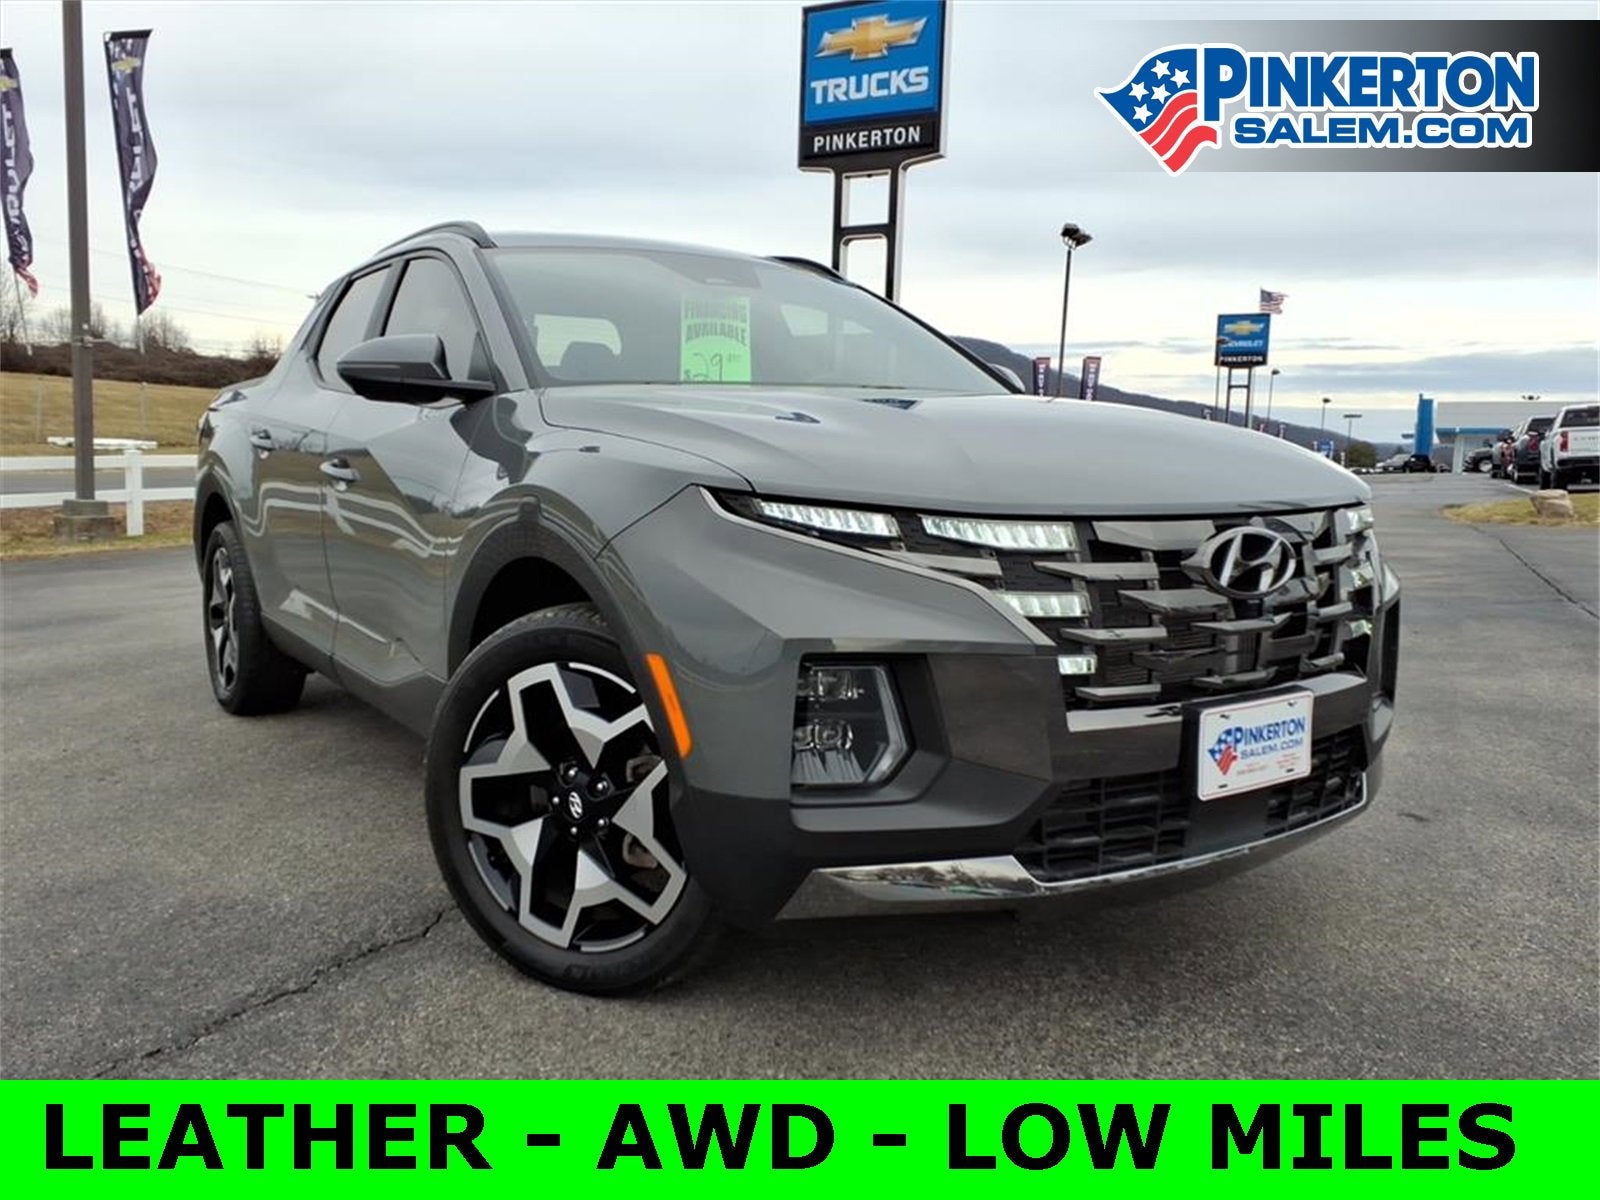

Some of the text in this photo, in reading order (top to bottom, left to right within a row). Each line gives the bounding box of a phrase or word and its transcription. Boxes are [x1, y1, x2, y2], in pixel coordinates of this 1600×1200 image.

[811, 66, 928, 104] TRUCKS
[814, 126, 920, 152] PINKERTON
[685, 322, 746, 346] AVAILABLE
[1233, 716, 1305, 752] PINKERTON
[1241, 738, 1303, 759] SALEM.COM
